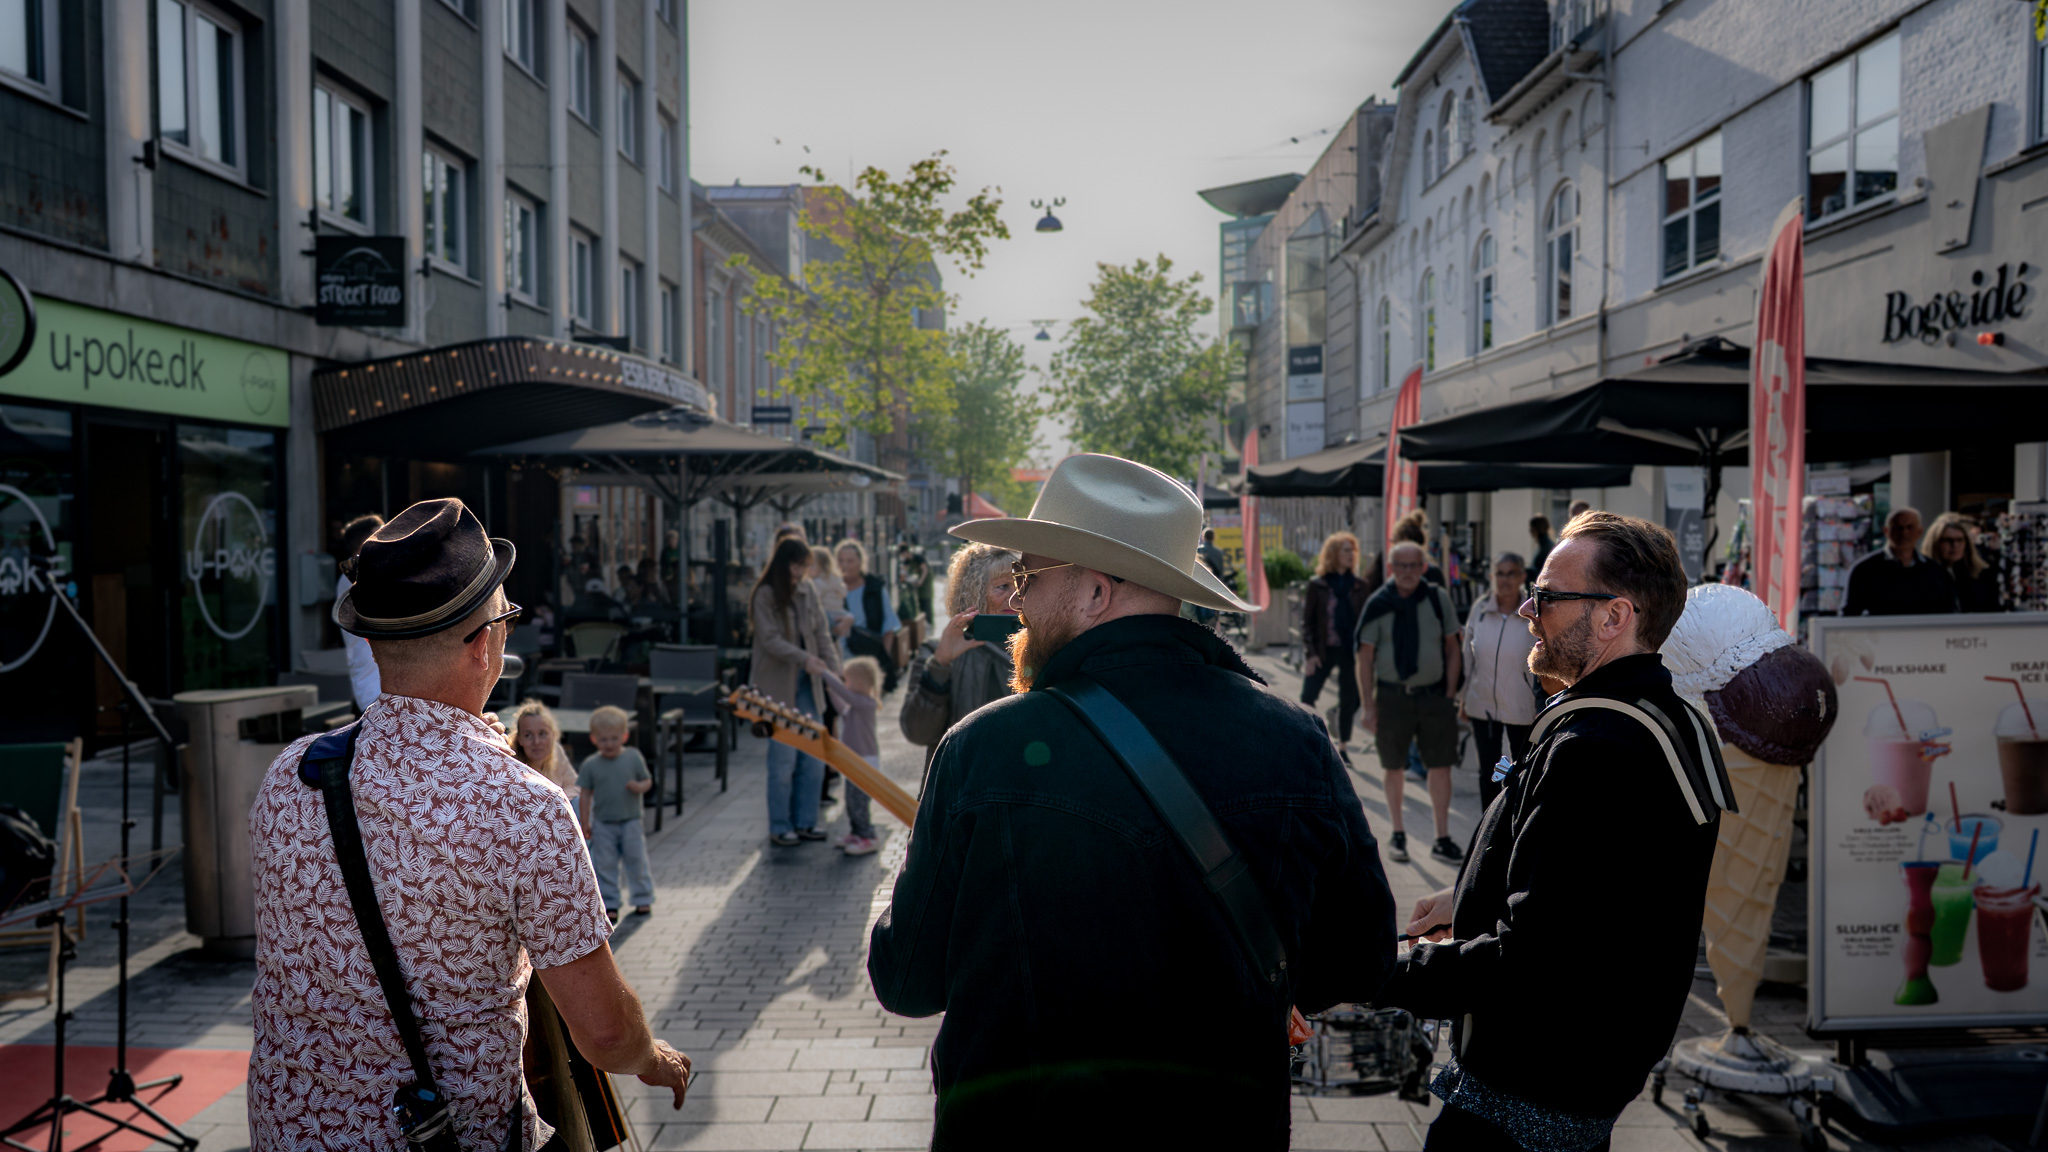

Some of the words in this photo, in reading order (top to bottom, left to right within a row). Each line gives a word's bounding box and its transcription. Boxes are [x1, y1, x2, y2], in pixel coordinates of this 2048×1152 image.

[319, 283, 369, 307] STREET
[370, 283, 402, 306] FOOD
[50, 328, 206, 392] u-poke.dk
[186, 548, 276, 580] U-POKE
[1874, 663, 1947, 675] MILKSHAKE
[2010, 661, 2048, 672] ISKAF
[2021, 672, 2041, 683] ICE
[1836, 923, 1878, 935] SLUSH
[1880, 922, 1901, 934] ICE
